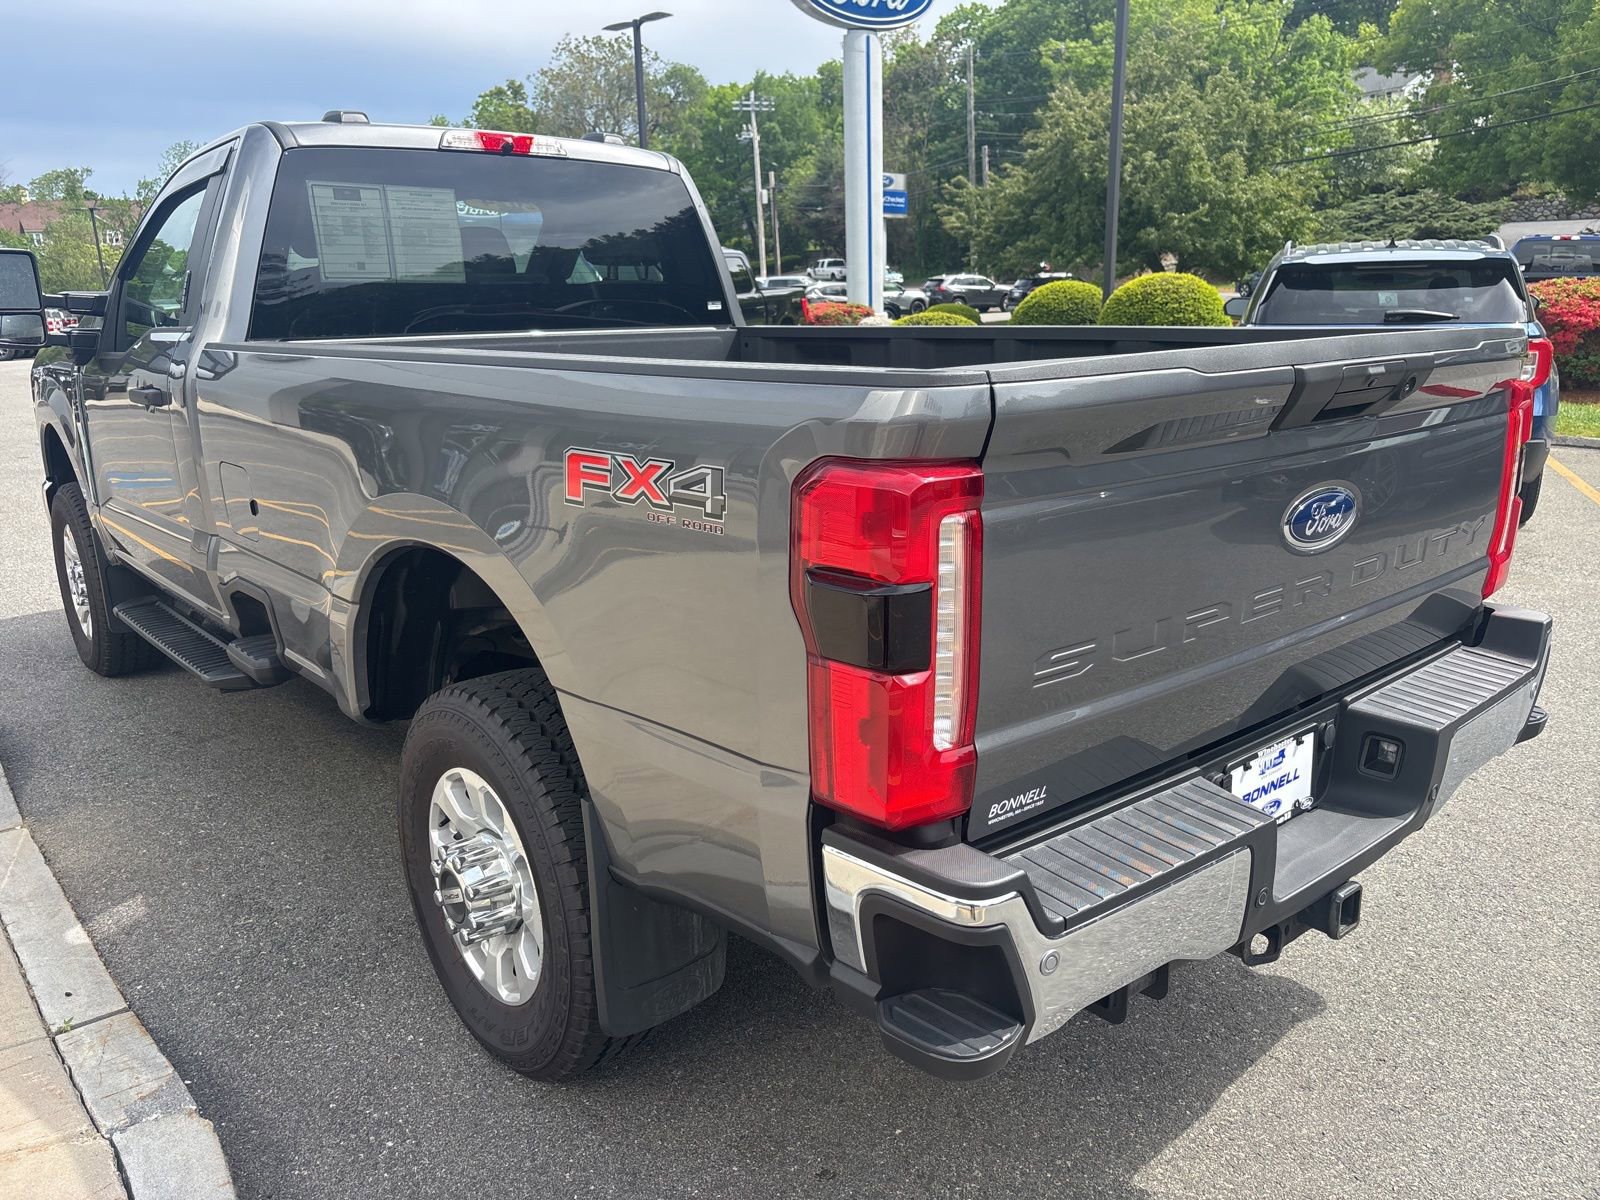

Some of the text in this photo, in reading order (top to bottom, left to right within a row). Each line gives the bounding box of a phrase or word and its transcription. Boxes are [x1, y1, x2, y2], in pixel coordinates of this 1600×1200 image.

[563, 446, 728, 522] FX4
[647, 512, 725, 536] OFF ROAD
[1305, 500, 1345, 536] Ford
[1032, 514, 1488, 688] SUPER DUTY
[988, 785, 1047, 818] BONNELL
[1243, 768, 1300, 804] BONNELL
